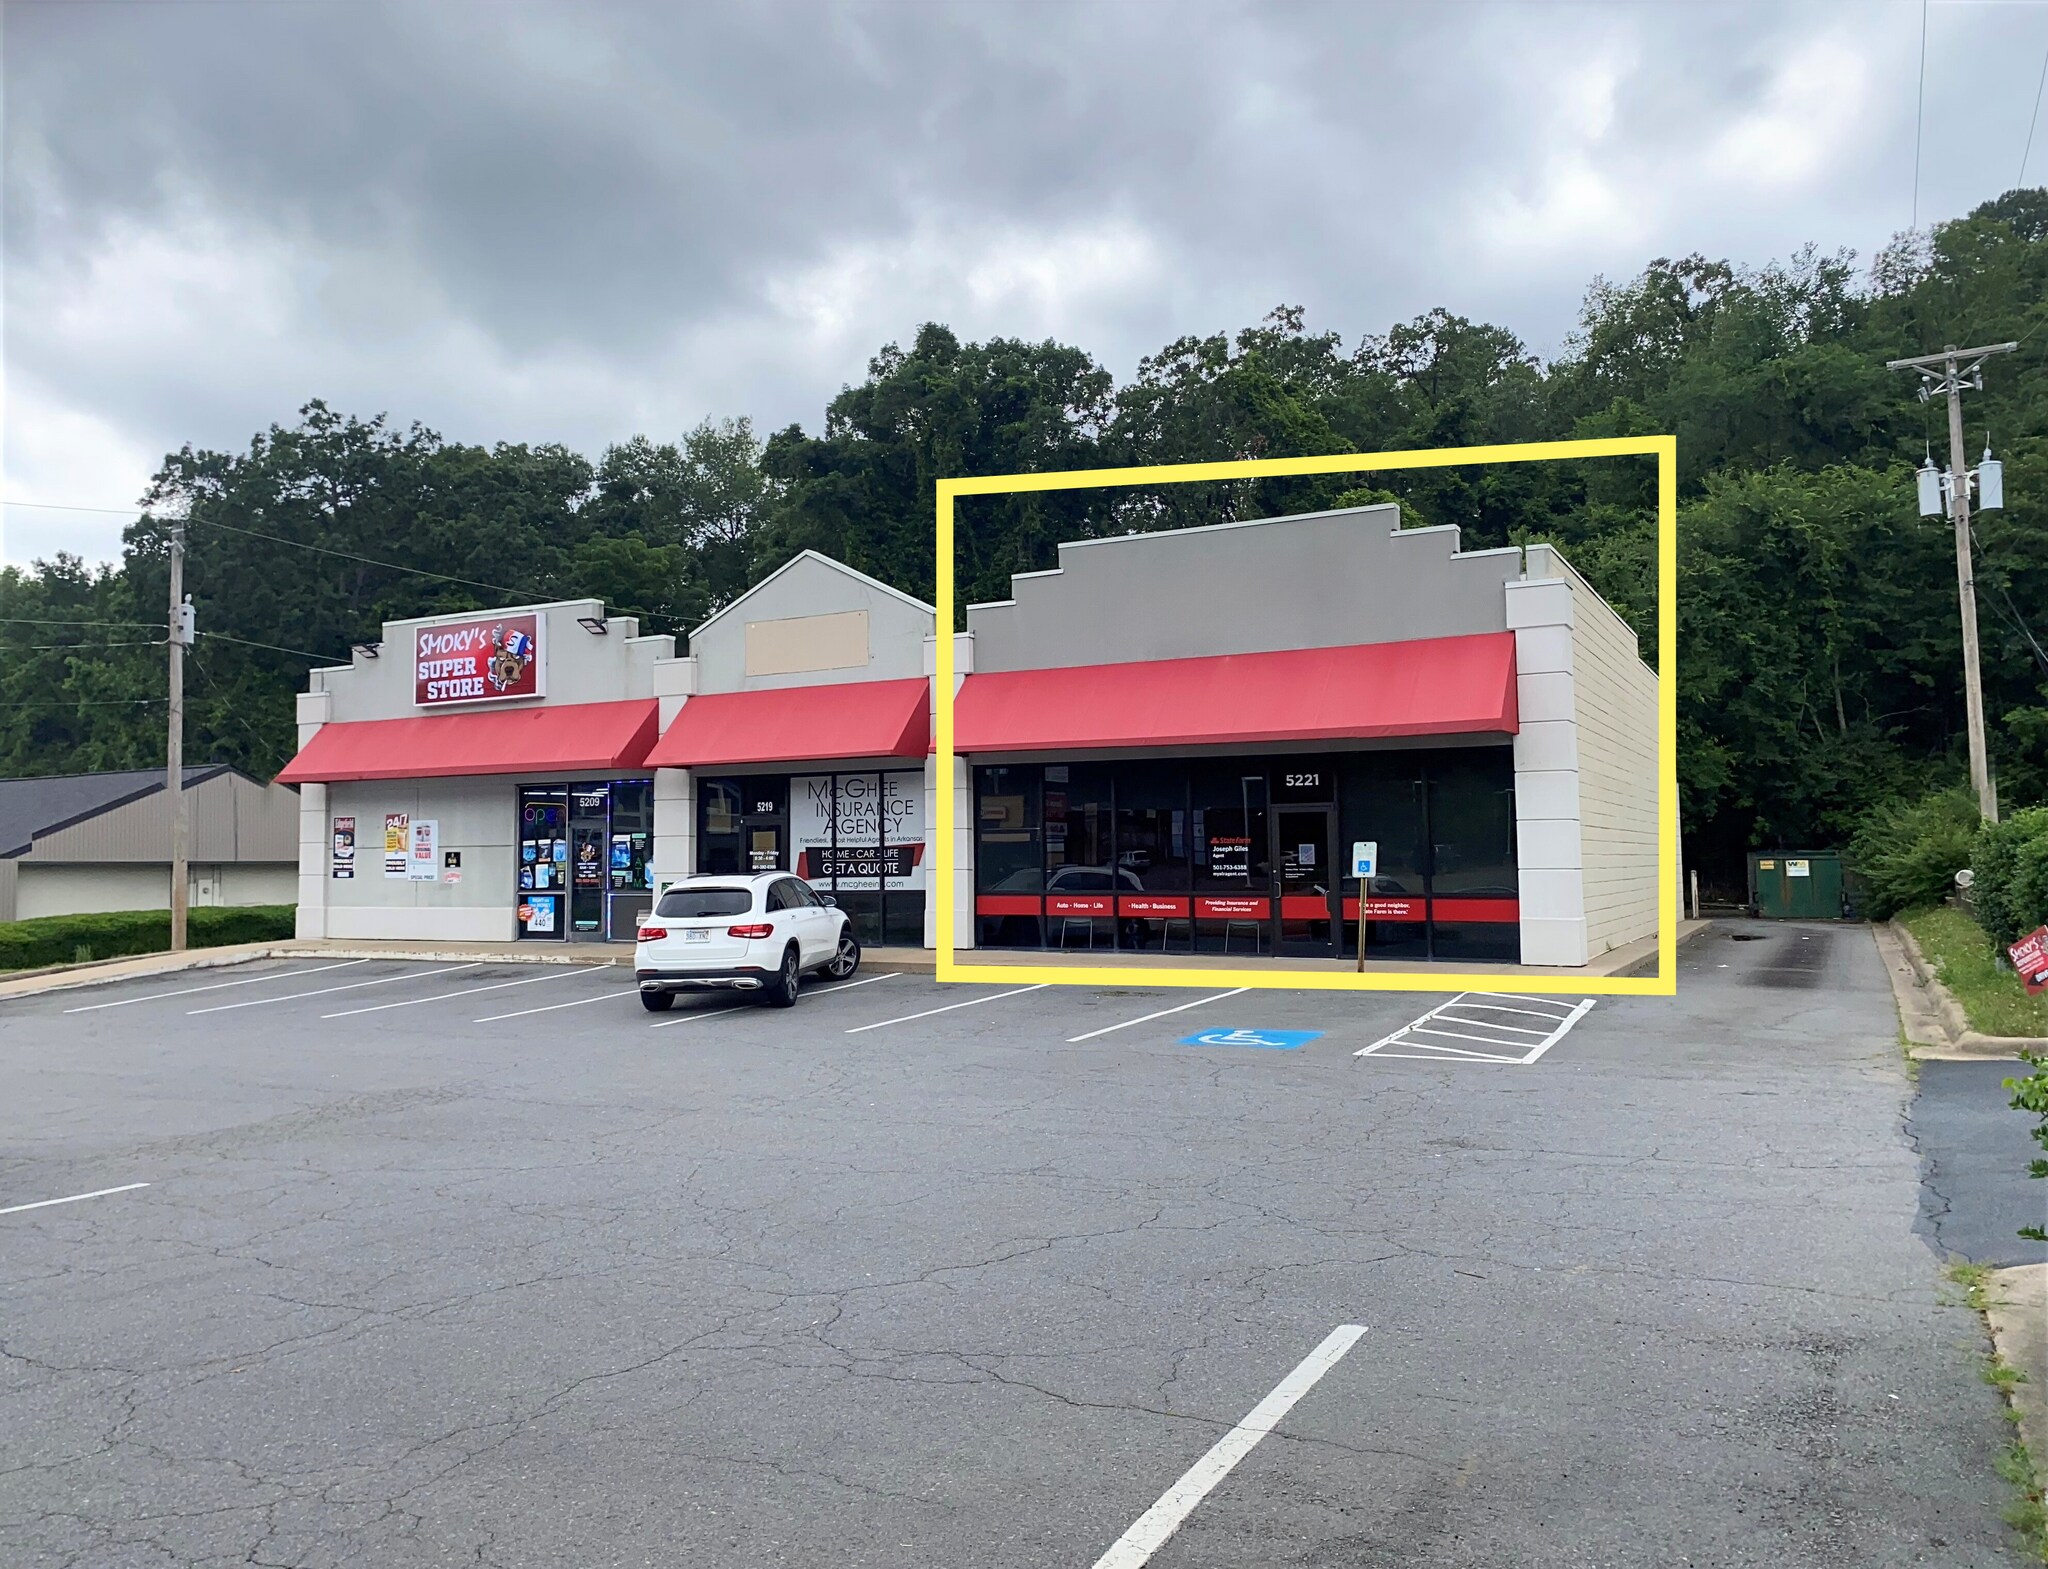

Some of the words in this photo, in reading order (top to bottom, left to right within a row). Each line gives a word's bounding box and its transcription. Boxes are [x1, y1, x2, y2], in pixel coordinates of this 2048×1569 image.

[419, 627, 486, 657] SMOKY'S
[419, 657, 477, 679] SUPER
[428, 677, 484, 699] STORE
[1286, 774, 1319, 786] 5221
[580, 798, 600, 807] 5209
[757, 802, 773, 812] 5219
[816, 800, 914, 817] INSURANCE
[823, 818, 903, 834] AGENCY
[847, 836, 867, 844] Helpful
[856, 850, 875, 858] CAR
[884, 849, 899, 858] LIFE
[822, 863, 846, 875] GET
[847, 863, 857, 874] A
[858, 862, 899, 874] QUOTE
